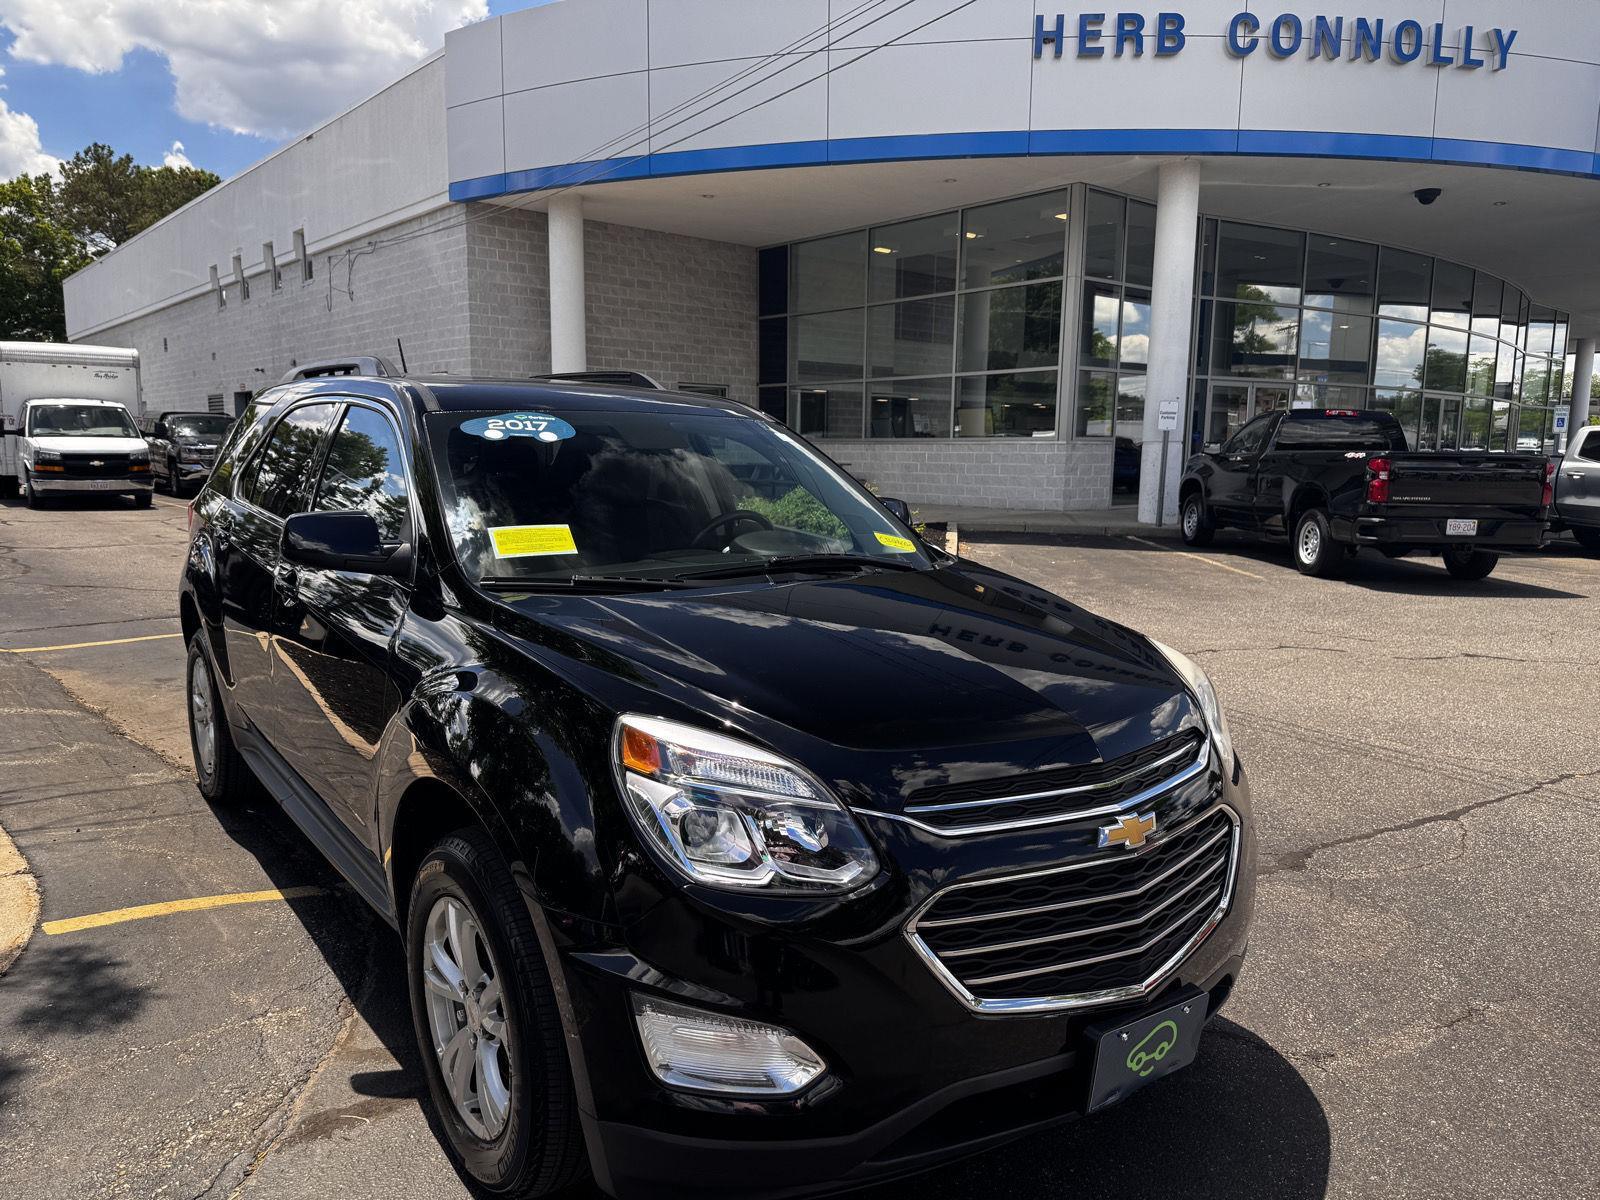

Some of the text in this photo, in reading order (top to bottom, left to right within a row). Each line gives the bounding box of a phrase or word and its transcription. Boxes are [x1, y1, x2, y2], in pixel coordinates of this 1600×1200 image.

[1034, 12, 1518, 71] HERB CONNOLLY
[487, 418, 548, 432] 2017
